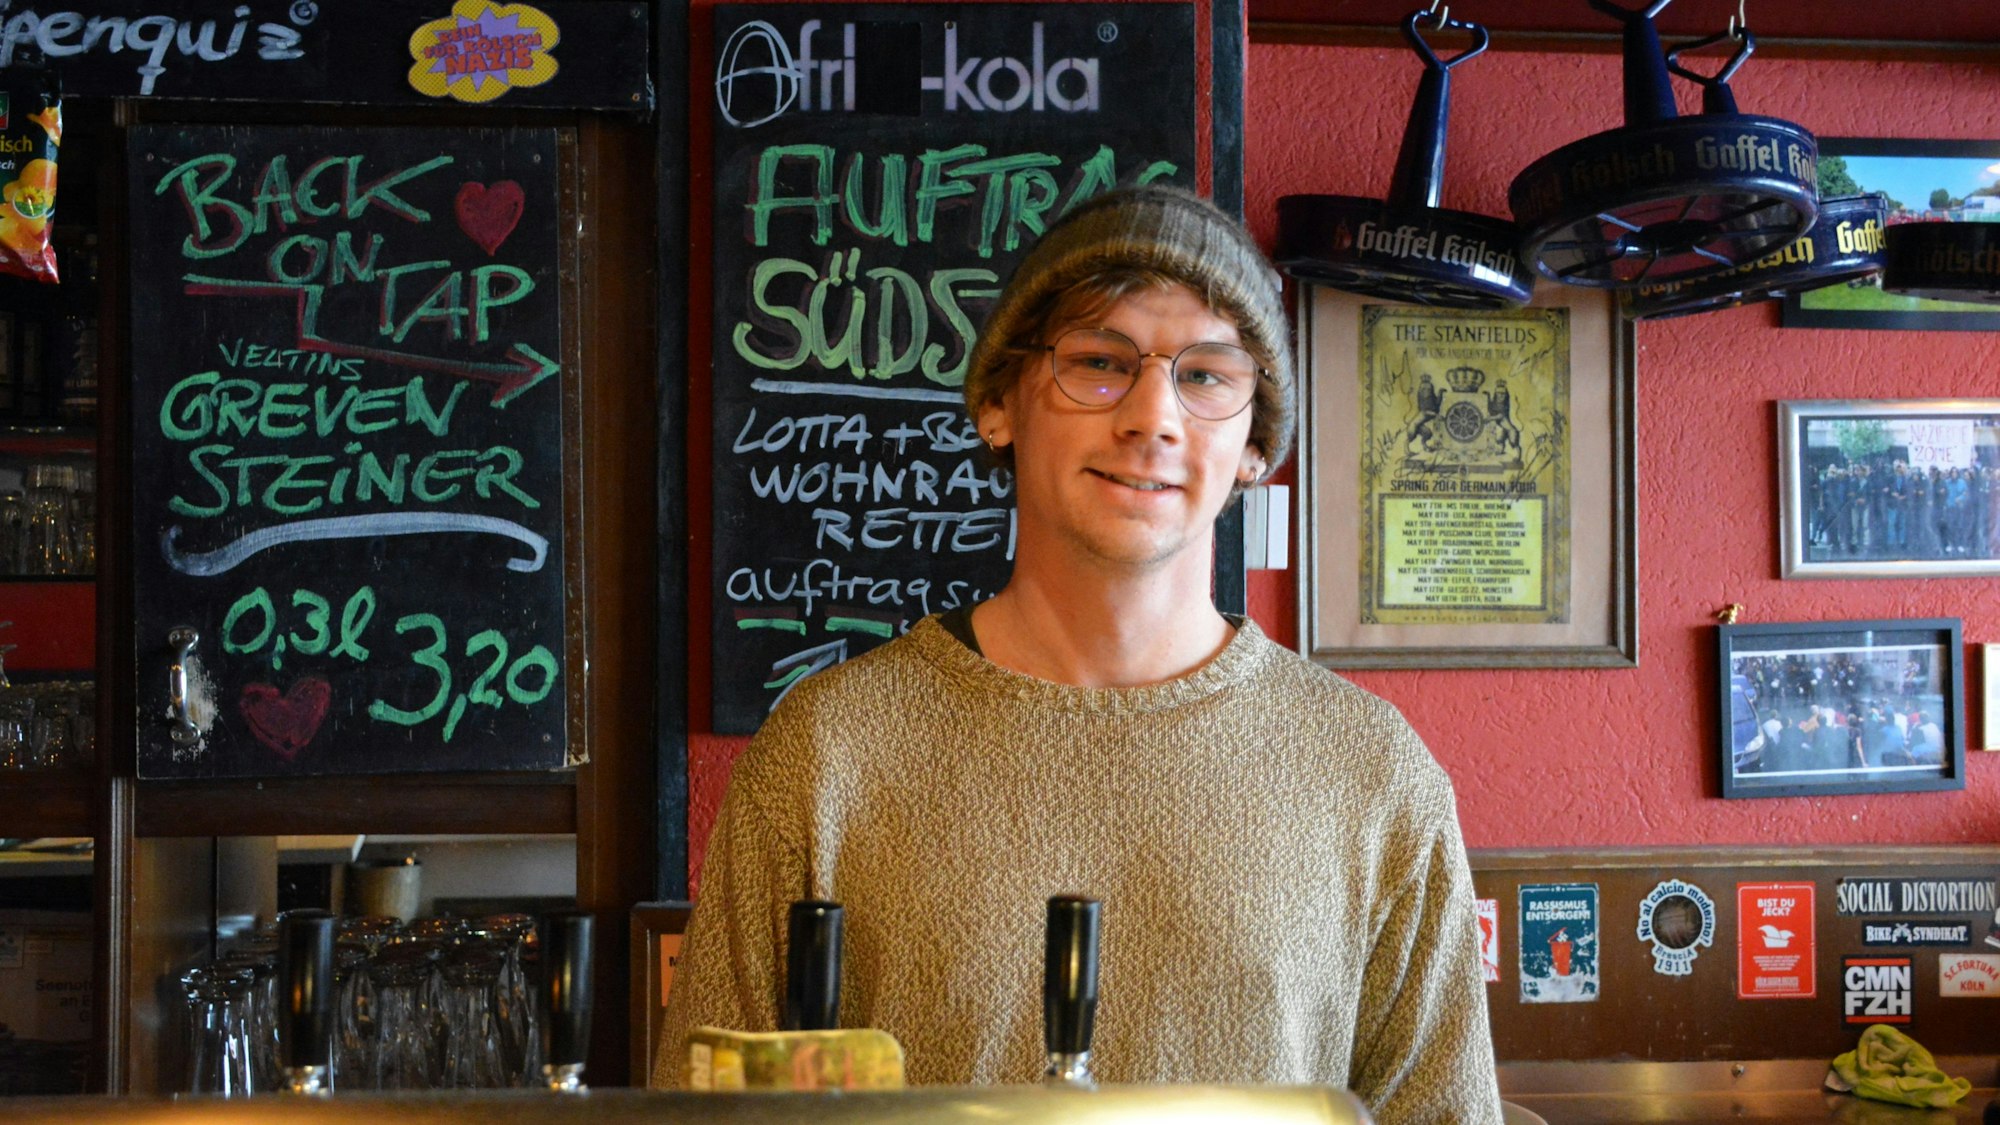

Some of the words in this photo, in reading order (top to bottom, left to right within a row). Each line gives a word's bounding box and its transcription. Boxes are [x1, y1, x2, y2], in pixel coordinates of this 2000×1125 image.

[439, 23, 482, 43] KEIN
[463, 32, 542, 54] KÖLSCH
[423, 43, 459, 60] FÜR
[445, 46, 534, 76] NAZIS
[1695, 134, 1783, 173] Gaffel
[154, 153, 454, 259] BACK
[744, 143, 1178, 258] AUFTRA
[265, 232, 385, 286] ON
[1356, 221, 1438, 261] Gaffel
[1440, 234, 1516, 278] Kölsch
[371, 259, 536, 345] TAP
[733, 247, 1002, 385] SÜDS
[1393, 324, 1426, 342] THE
[1433, 325, 1538, 345] STANFIELDS
[218, 341, 365, 381] VELTINS
[159, 372, 470, 441] GREVEN
[732, 407, 873, 454] LOTTA
[1391, 480, 1429, 492] SPRING
[1432, 480, 1458, 492] 2014
[1412, 502, 1427, 510] MAY
[1418, 511, 1432, 519] MAY
[1402, 529, 1417, 537] MAY
[1407, 538, 1421, 546] MAY
[1418, 548, 1431, 556] MAY
[1413, 585, 1427, 594] MAY
[1418, 576, 1431, 584] MAY
[1425, 594, 1439, 603] MAY
[367, 612, 560, 743] 3,20
[1529, 900, 1588, 912] RASSISMUS
[1757, 898, 1778, 908] BIST
[1780, 898, 1795, 908] DU
[1838, 880, 1893, 912] SOCIAL
[1901, 880, 1996, 912] DISTORTION
[1650, 882, 1685, 903] calcio
[1687, 887, 1713, 944] moderno!
[1761, 907, 1791, 917] JECK?
[1866, 925, 1893, 942] BIKE
[1658, 959, 1689, 972] 1911
[1844, 965, 1911, 991] CMN
[1844, 990, 1911, 1016] FZH
